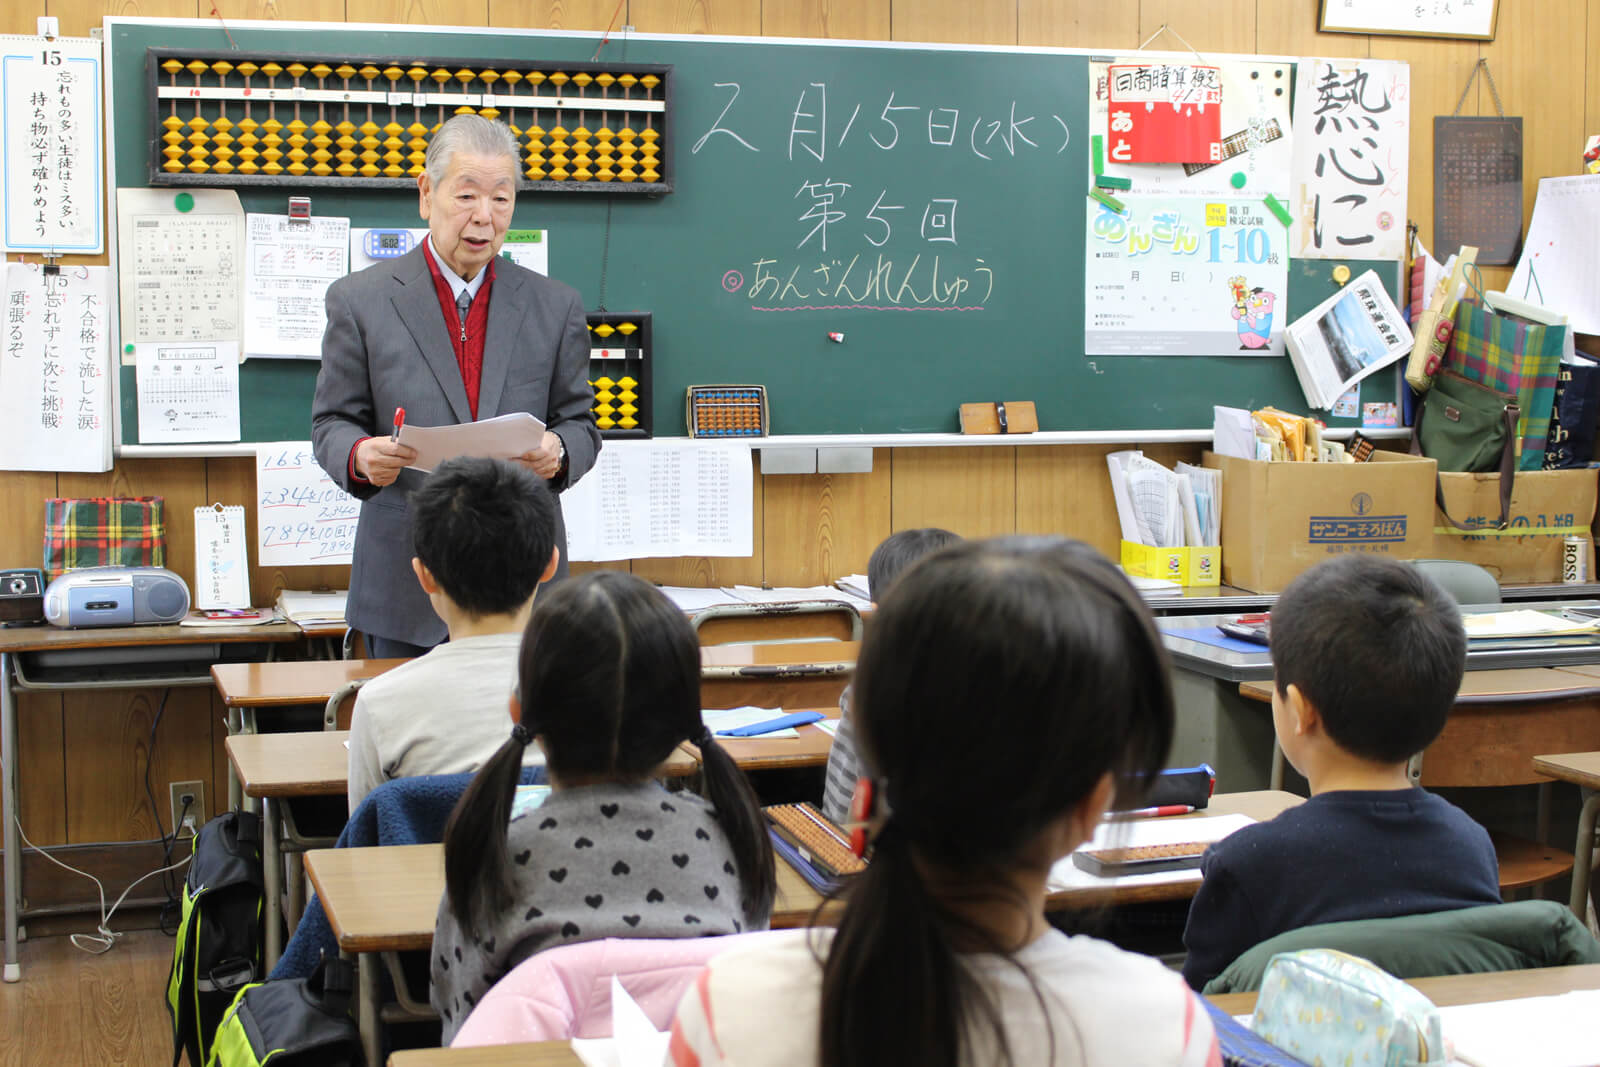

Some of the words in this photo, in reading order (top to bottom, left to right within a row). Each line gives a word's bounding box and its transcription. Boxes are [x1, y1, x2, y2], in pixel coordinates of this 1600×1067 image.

[41, 51, 62, 65] 15
[30, 91, 49, 238] 持ち物必ず確かめよう
[56, 70, 74, 229] 忘れもの多い生徒はミス多い
[1111, 110, 1133, 160] あと
[1314, 64, 1391, 248] 熱心に
[794, 178, 958, 251] 第5回
[1095, 204, 1199, 256] あんざん
[748, 254, 993, 304] あんざんれんしゅう
[1131, 270, 1140, 282] 月
[8, 290, 26, 358] 頑張るぞ
[41, 293, 61, 429] 忘れずに次に挑戦
[78, 293, 97, 430] 不合格で流した涙
[1311, 521, 1405, 537] サンコーそろばん
[1565, 544, 1577, 581] BOSS
